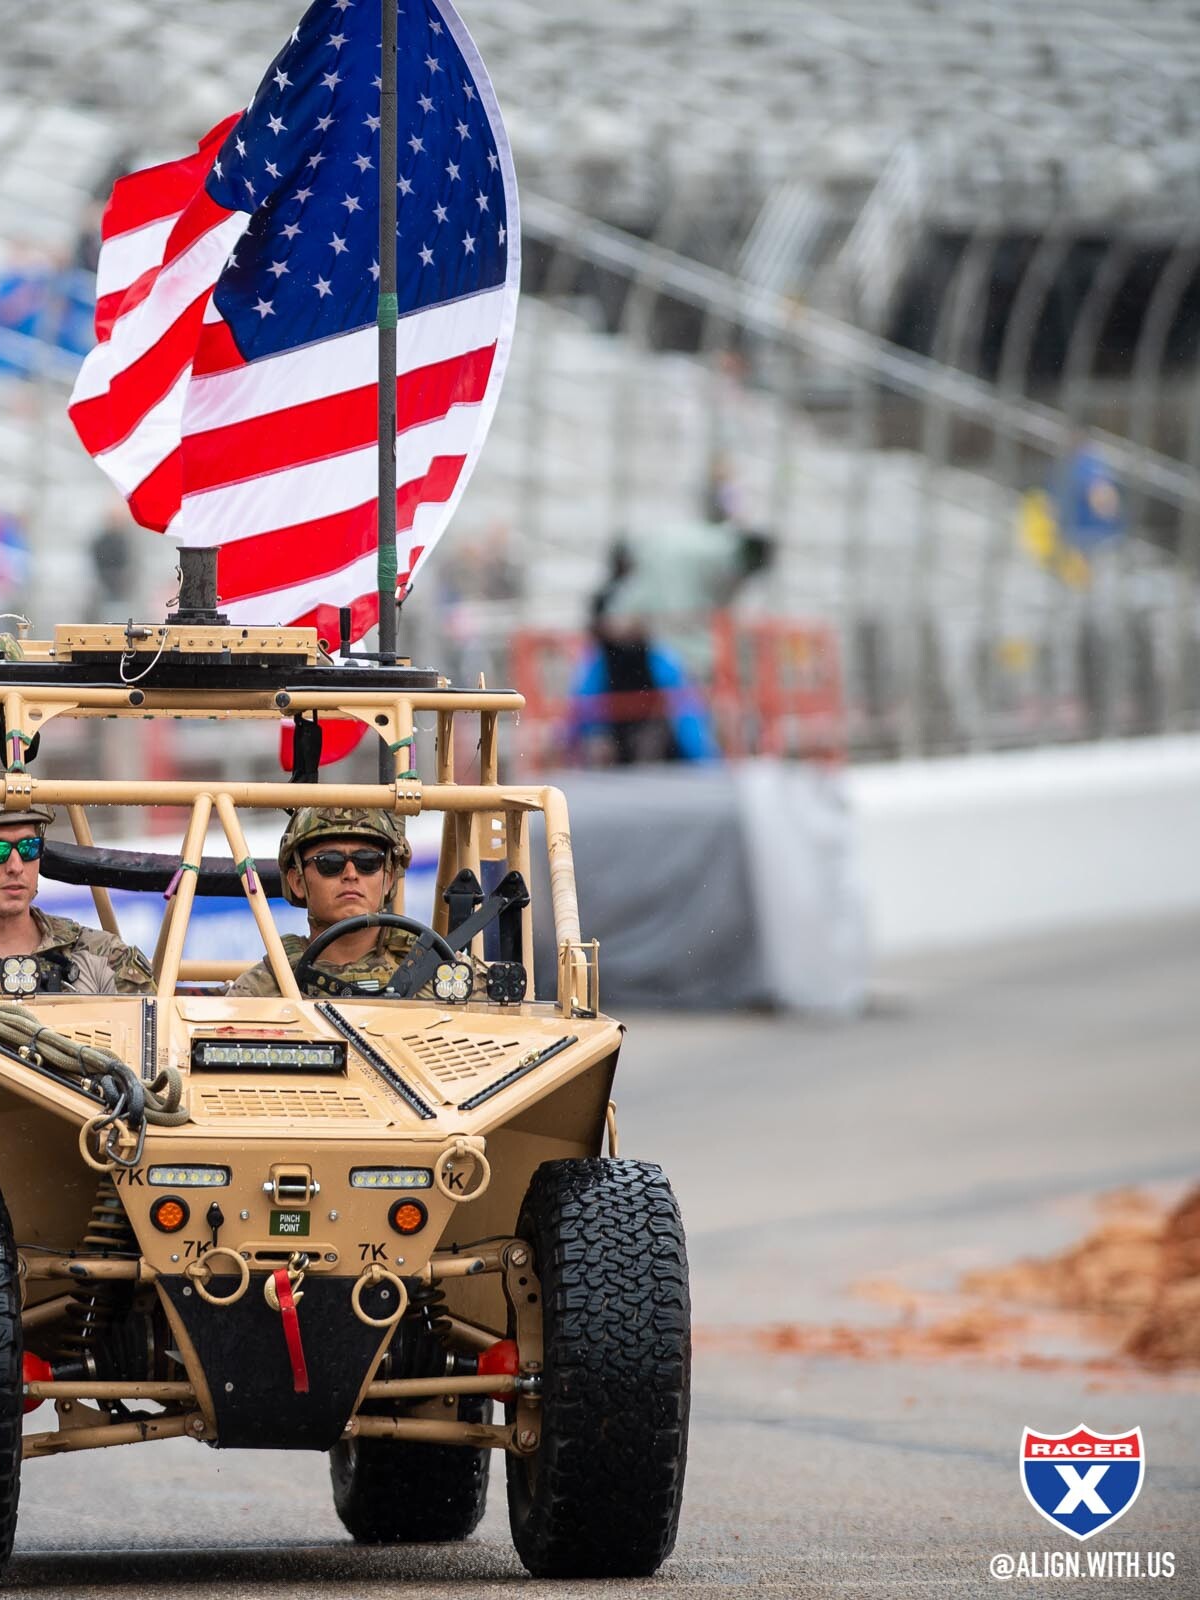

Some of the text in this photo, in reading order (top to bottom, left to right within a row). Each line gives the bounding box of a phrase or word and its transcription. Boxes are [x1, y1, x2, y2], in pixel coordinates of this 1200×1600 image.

[115, 1168, 144, 1186] 7K
[279, 1213, 301, 1223] PINCH
[279, 1223, 300, 1232] POINT
[183, 1240, 212, 1258] 7K
[358, 1243, 389, 1261] 7K
